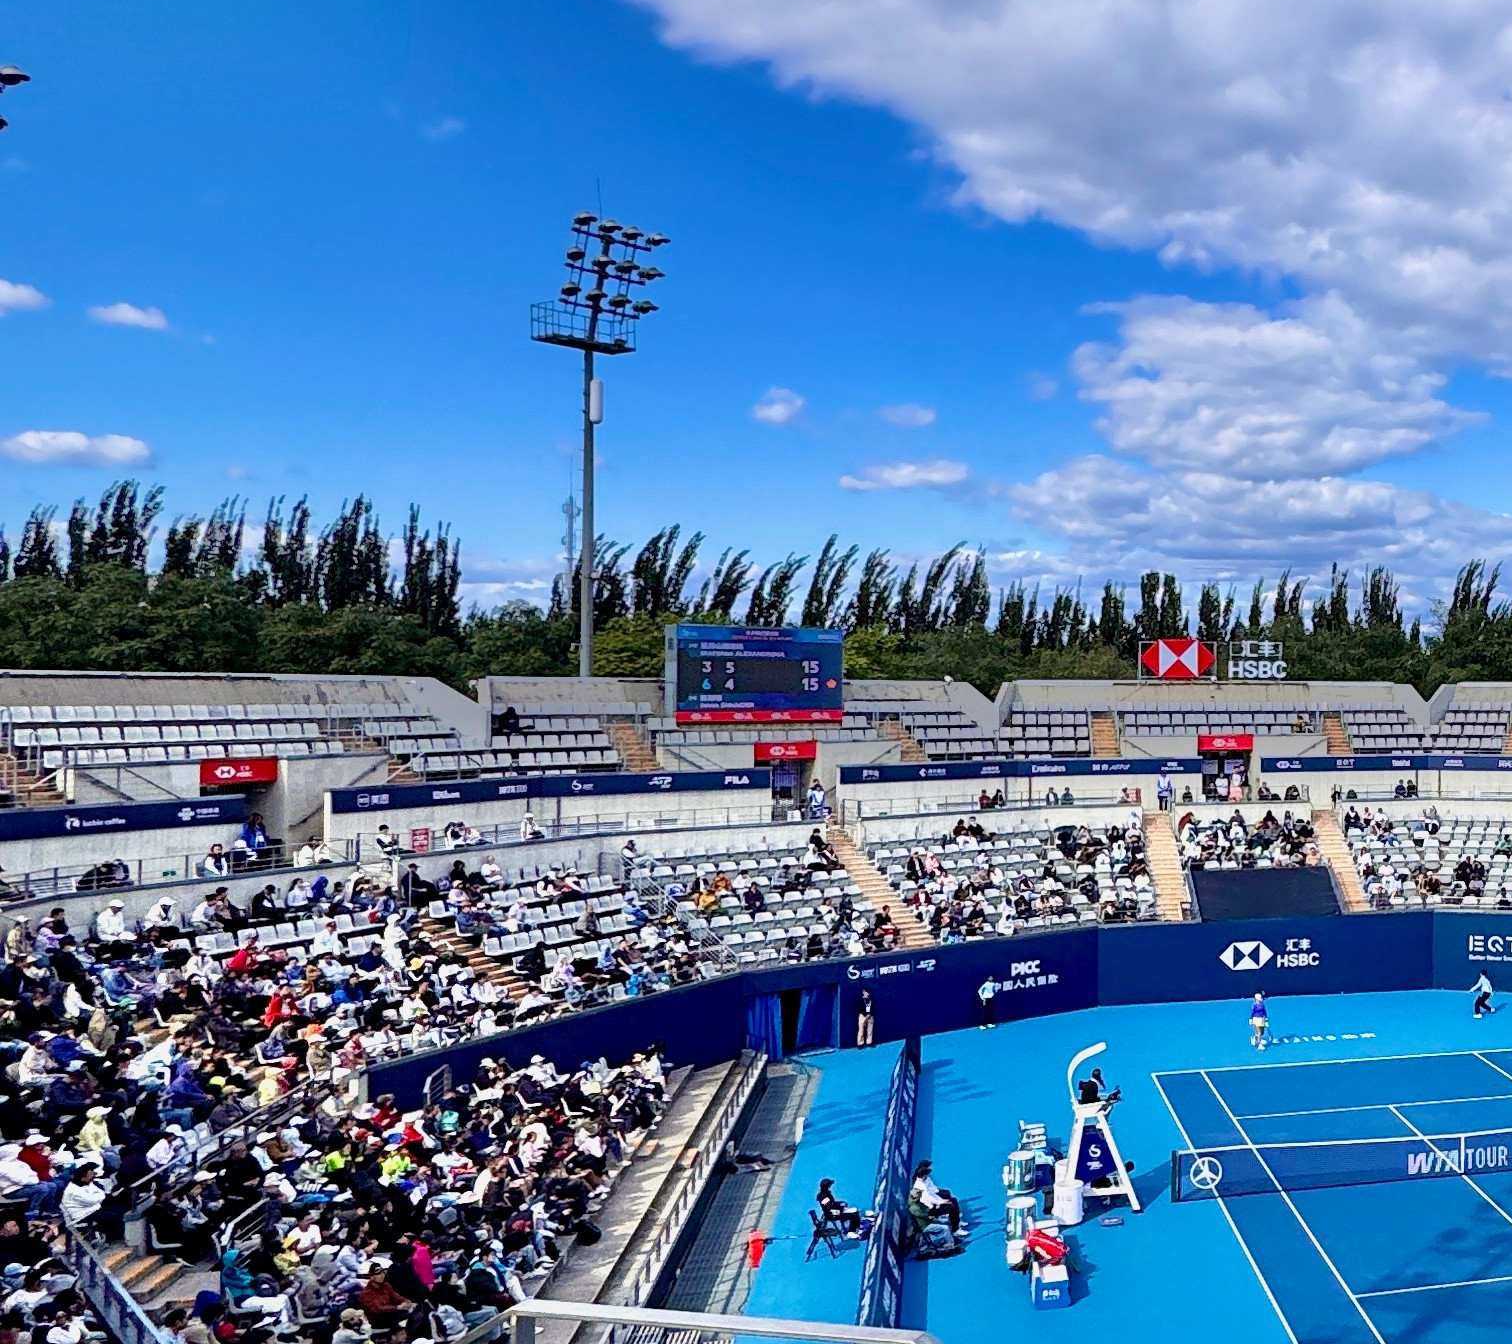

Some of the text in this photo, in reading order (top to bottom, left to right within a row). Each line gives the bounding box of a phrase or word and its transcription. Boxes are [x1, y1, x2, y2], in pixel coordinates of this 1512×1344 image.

[1241, 640, 1276, 657] 汇丰
[702, 661, 819, 673] 3 5 15
[1228, 660, 1287, 678] HSBC
[702, 678, 819, 691] 6 4 15
[724, 775, 750, 785] FILA
[1286, 938, 1311, 951] 汇丰
[1011, 960, 1041, 976] PICC
[1276, 952, 1320, 968] HSBC
[1465, 1145, 1509, 1170] TOUR
